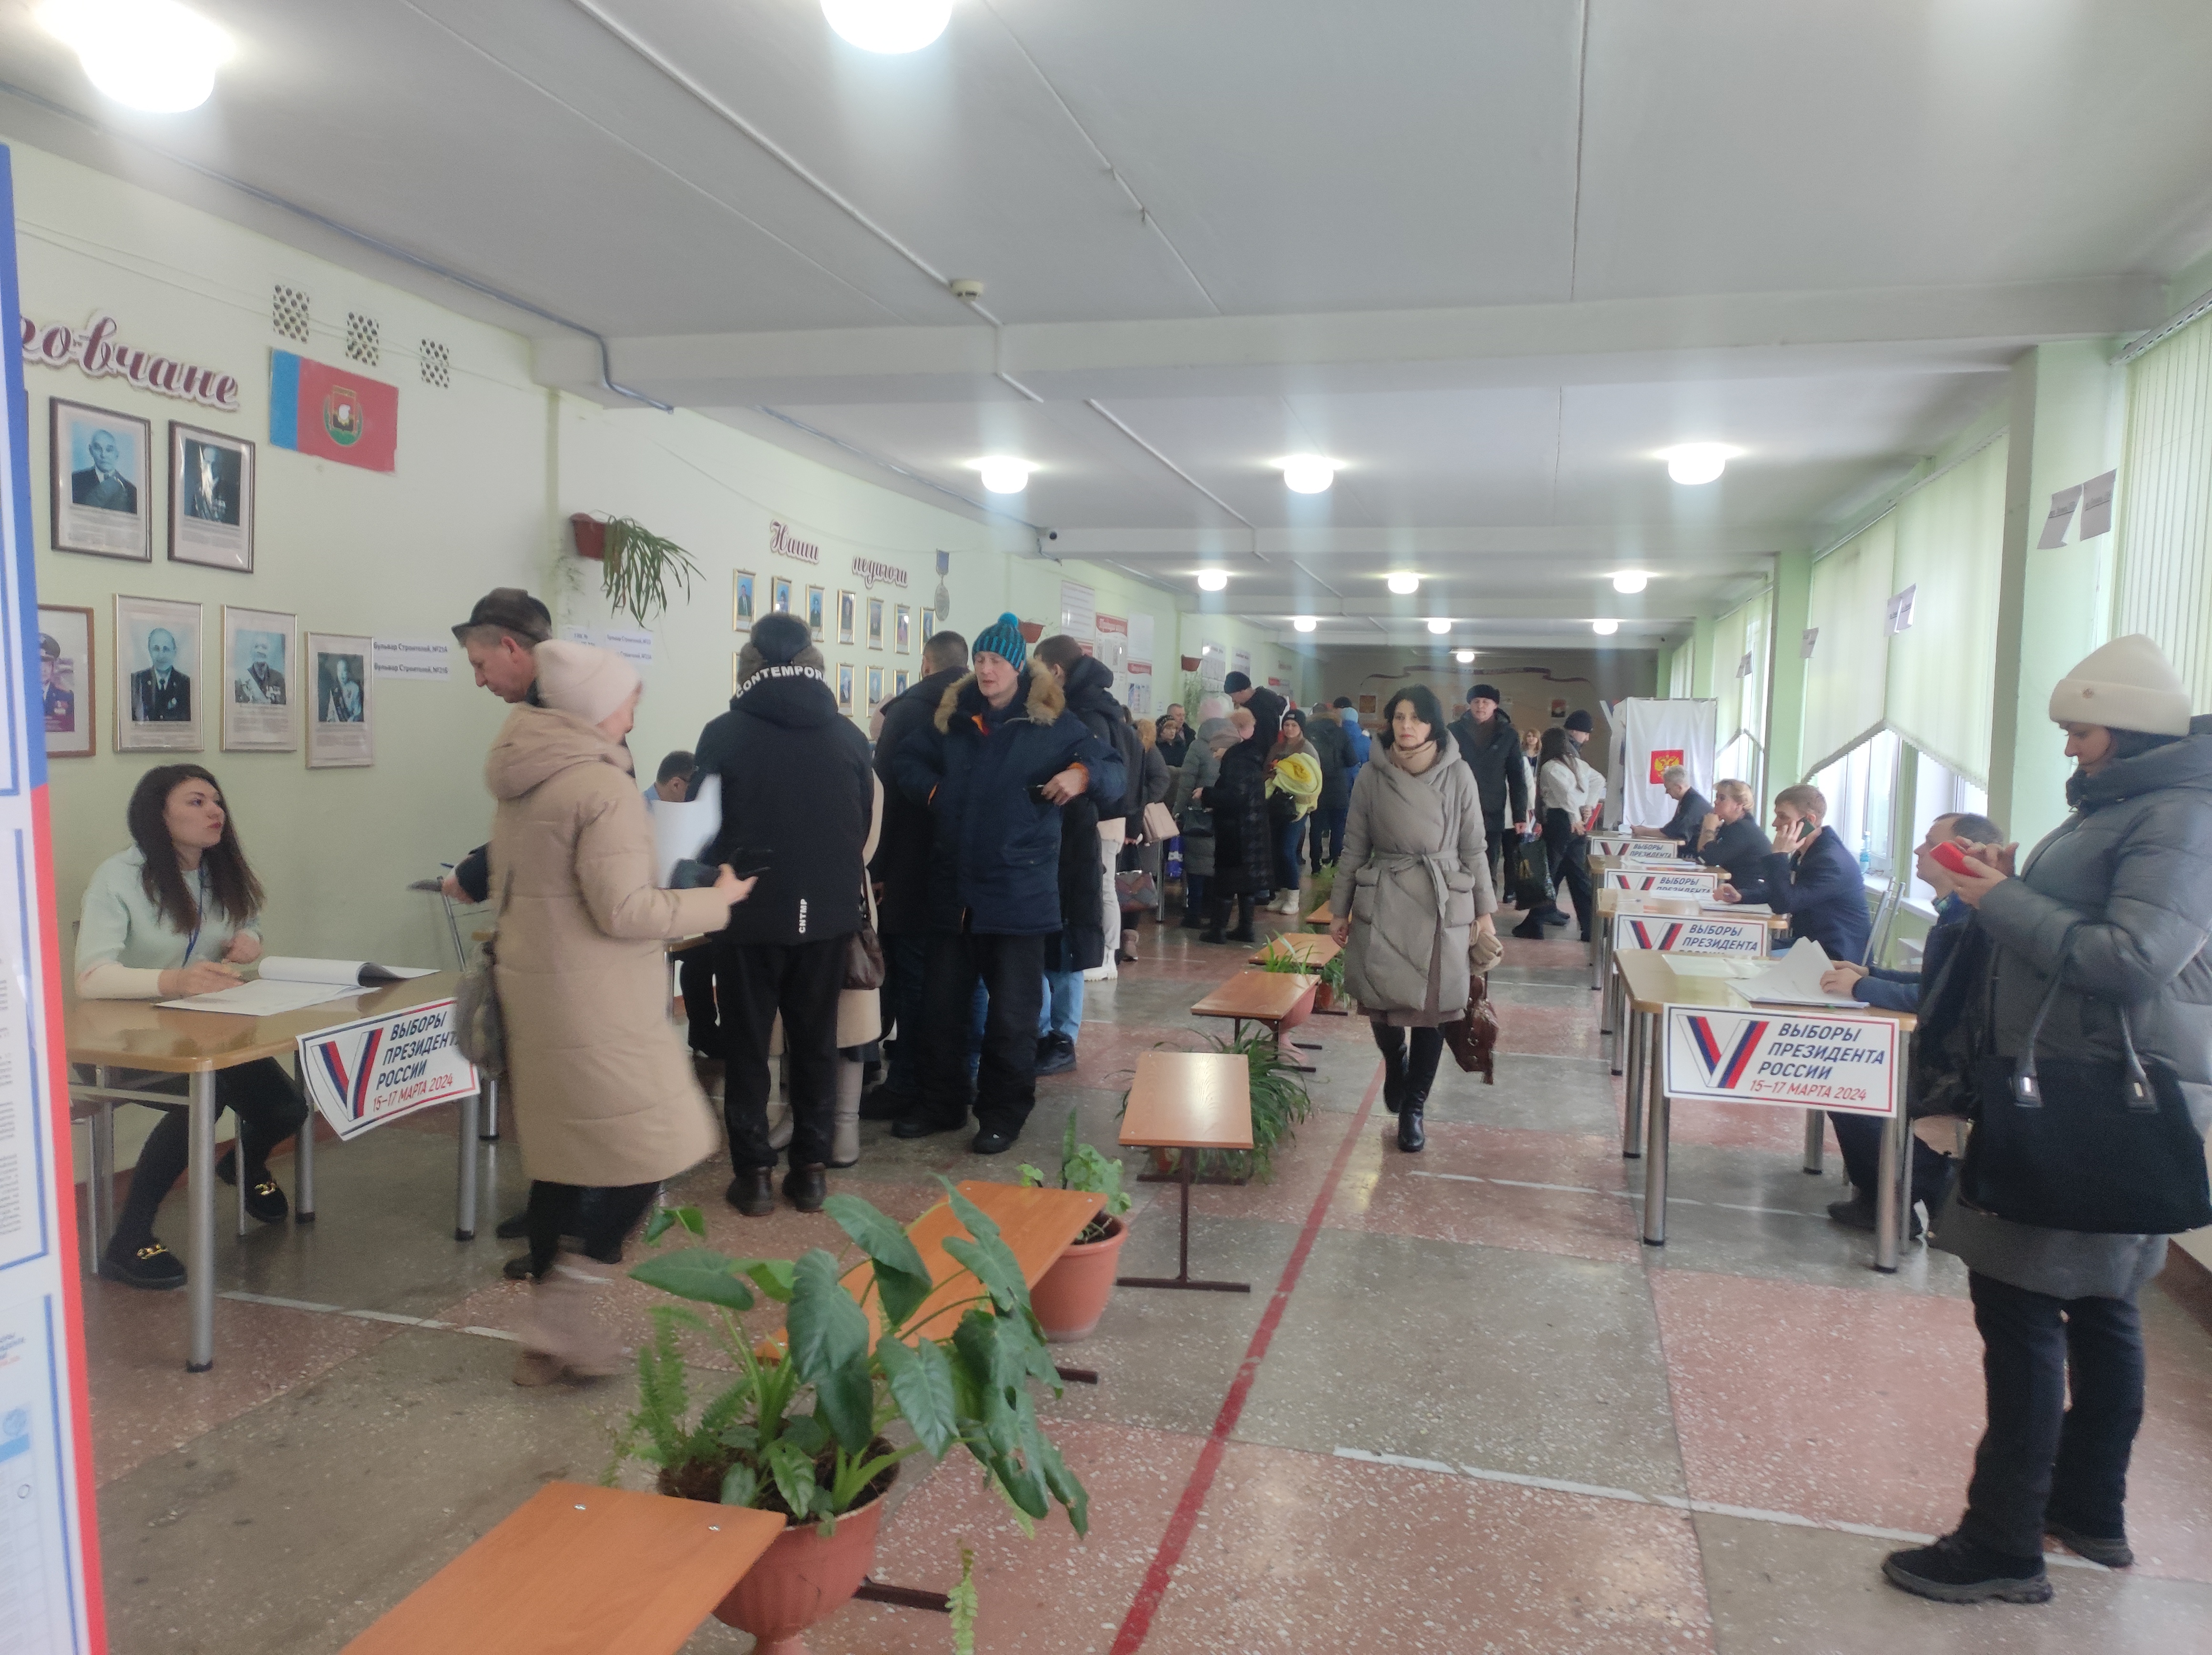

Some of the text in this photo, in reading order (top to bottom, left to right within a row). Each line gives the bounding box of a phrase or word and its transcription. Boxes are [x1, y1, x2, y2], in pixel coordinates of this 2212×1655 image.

[736, 665, 827, 698] CONTEMPOR
[1659, 877, 1700, 886] ВЫБОРЫ
[1688, 924, 1743, 937] ВЫБОРЫ
[1681, 937, 1759, 951] ПРЕЗИДЕНТА
[390, 1011, 447, 1041] ВЫБОРЫ
[1777, 1022, 1862, 1042] ВЫБОРЫ
[382, 1031, 458, 1066] ПРЕЗИДЕНТ
[1766, 1042, 1886, 1065] ПРЕЗИДЕНТА
[375, 1059, 428, 1091] РОССИИ
[1757, 1062, 1833, 1080] РОССИИ
[397, 1081, 427, 1104] МАРТА
[428, 1072, 453, 1093] 2024
[1787, 1082, 1832, 1099] МАРТА
[1833, 1085, 1867, 1101] 2024
